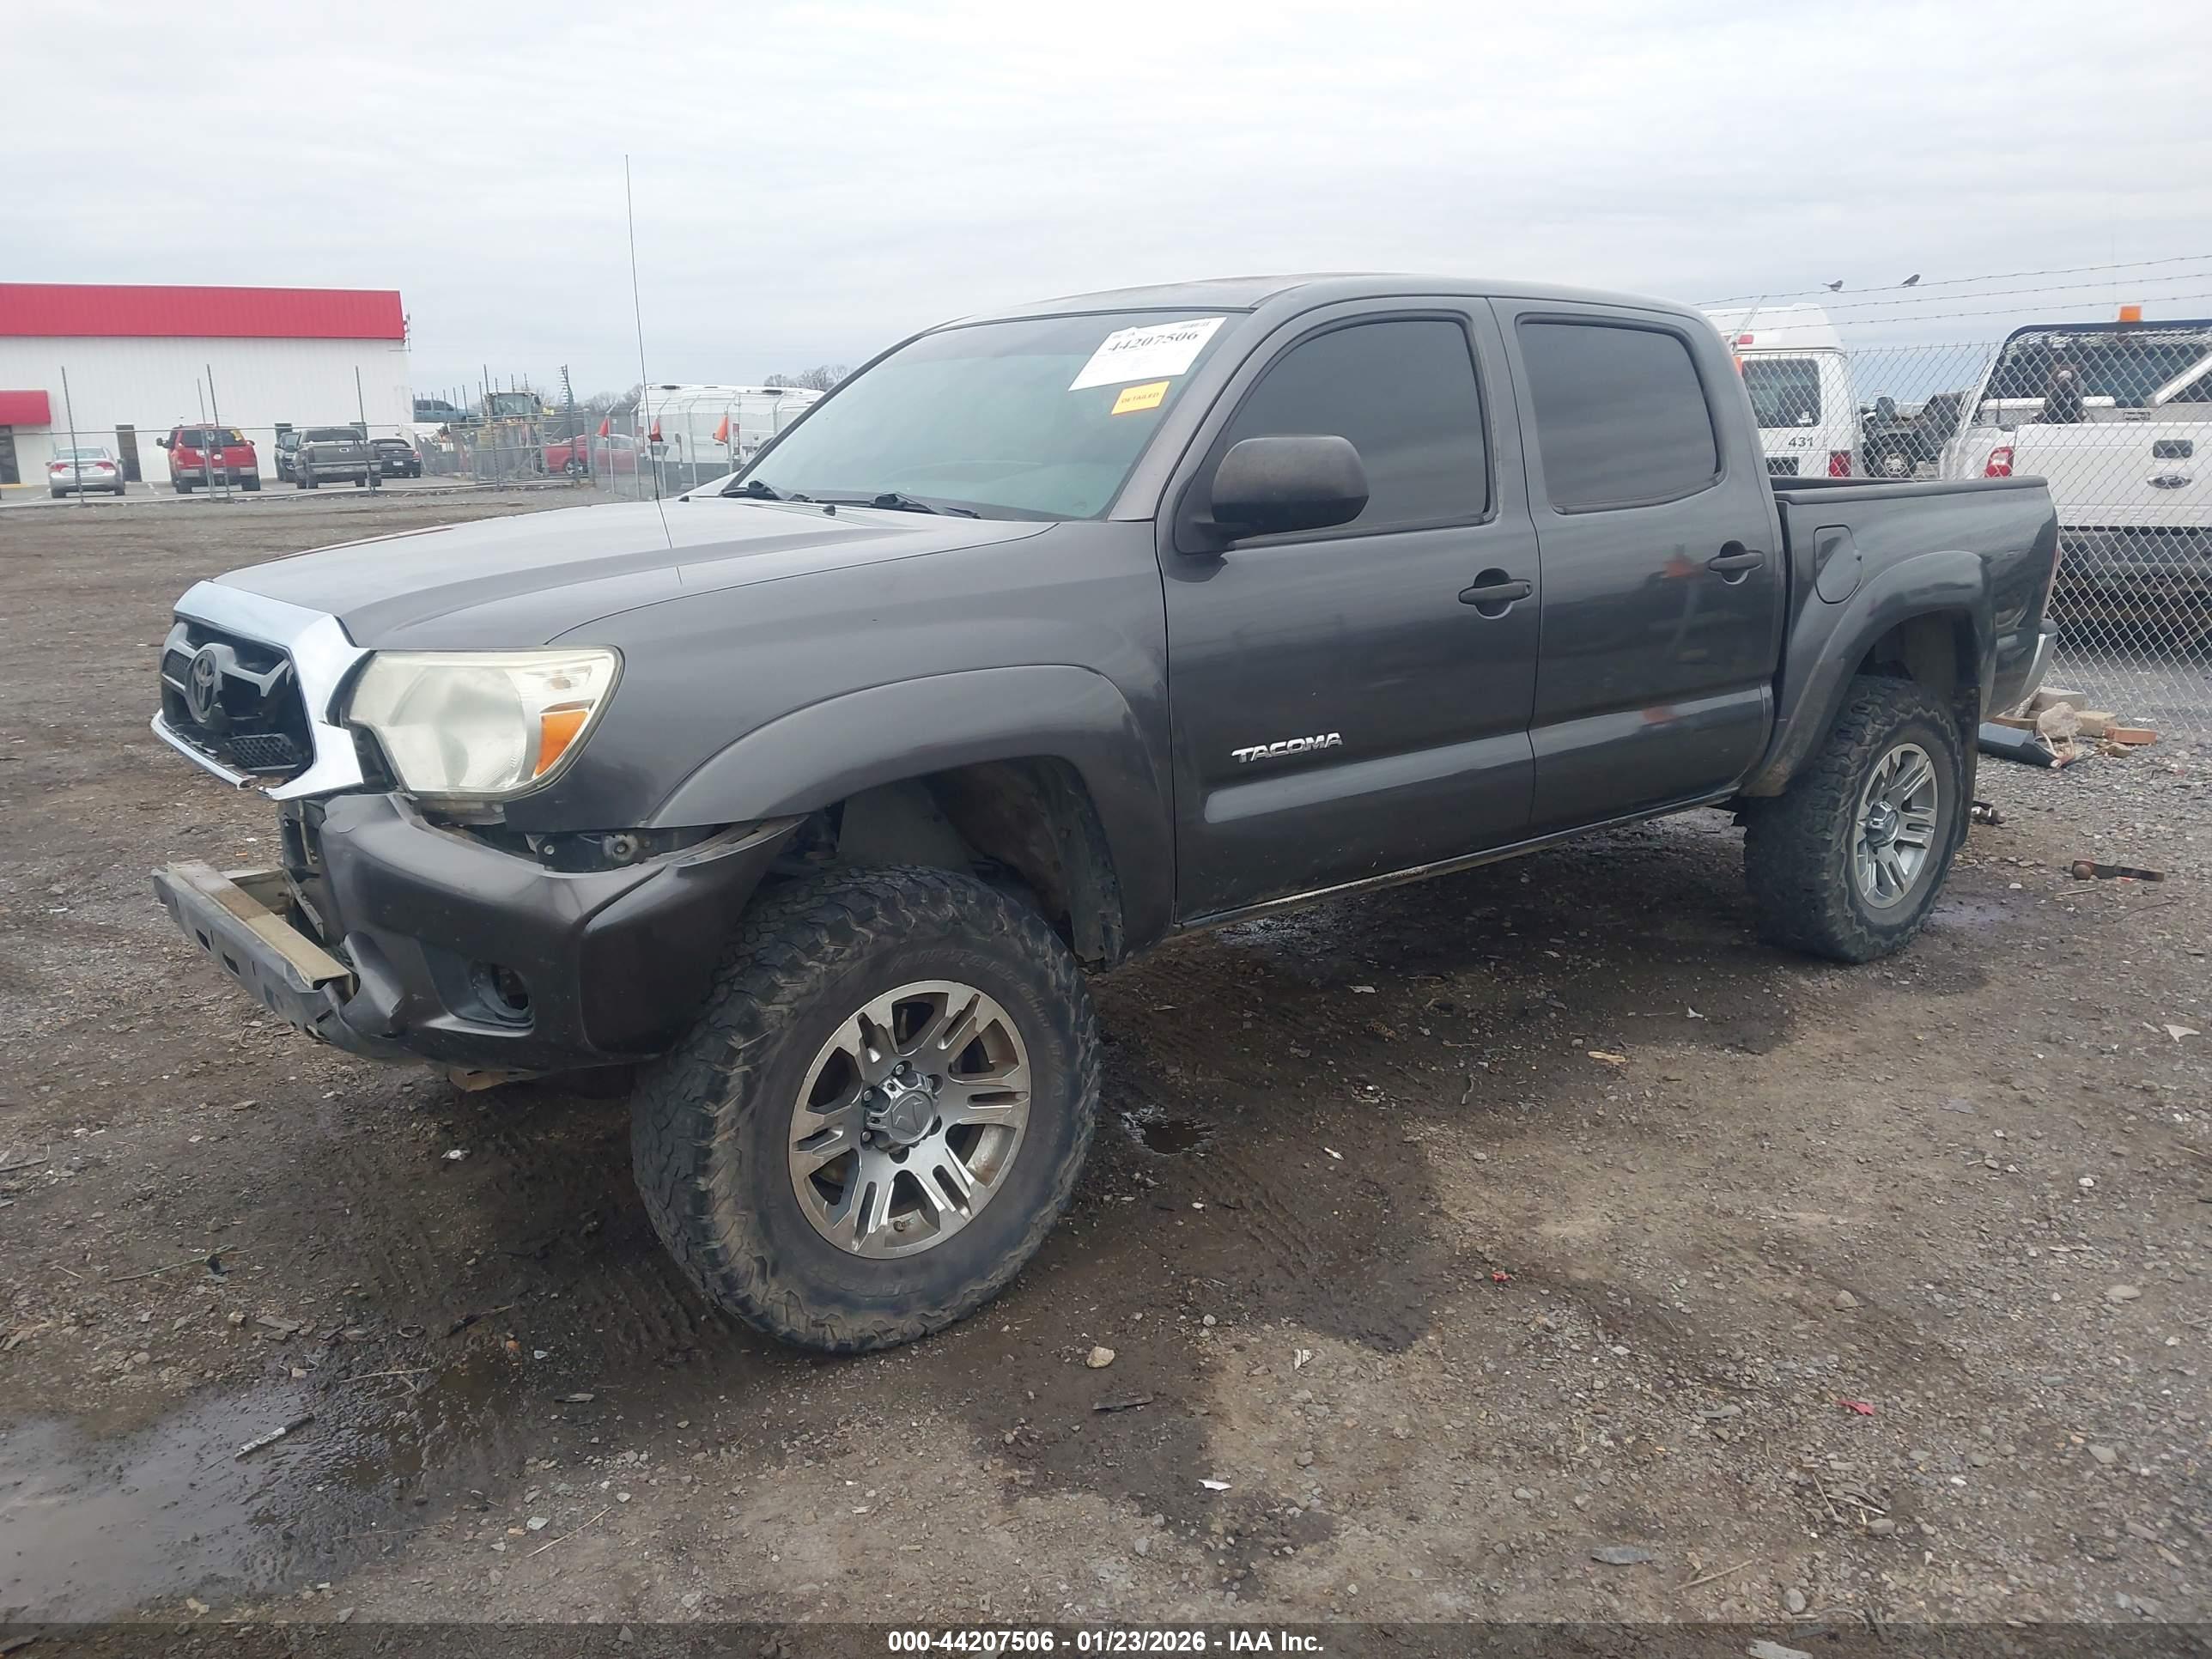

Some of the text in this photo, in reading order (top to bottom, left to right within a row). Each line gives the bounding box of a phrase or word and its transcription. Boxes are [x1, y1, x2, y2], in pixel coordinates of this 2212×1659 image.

[1108, 331, 1200, 352] 44207506
[1788, 436, 1814, 447] 431
[1231, 732, 1343, 763] TACOMA
